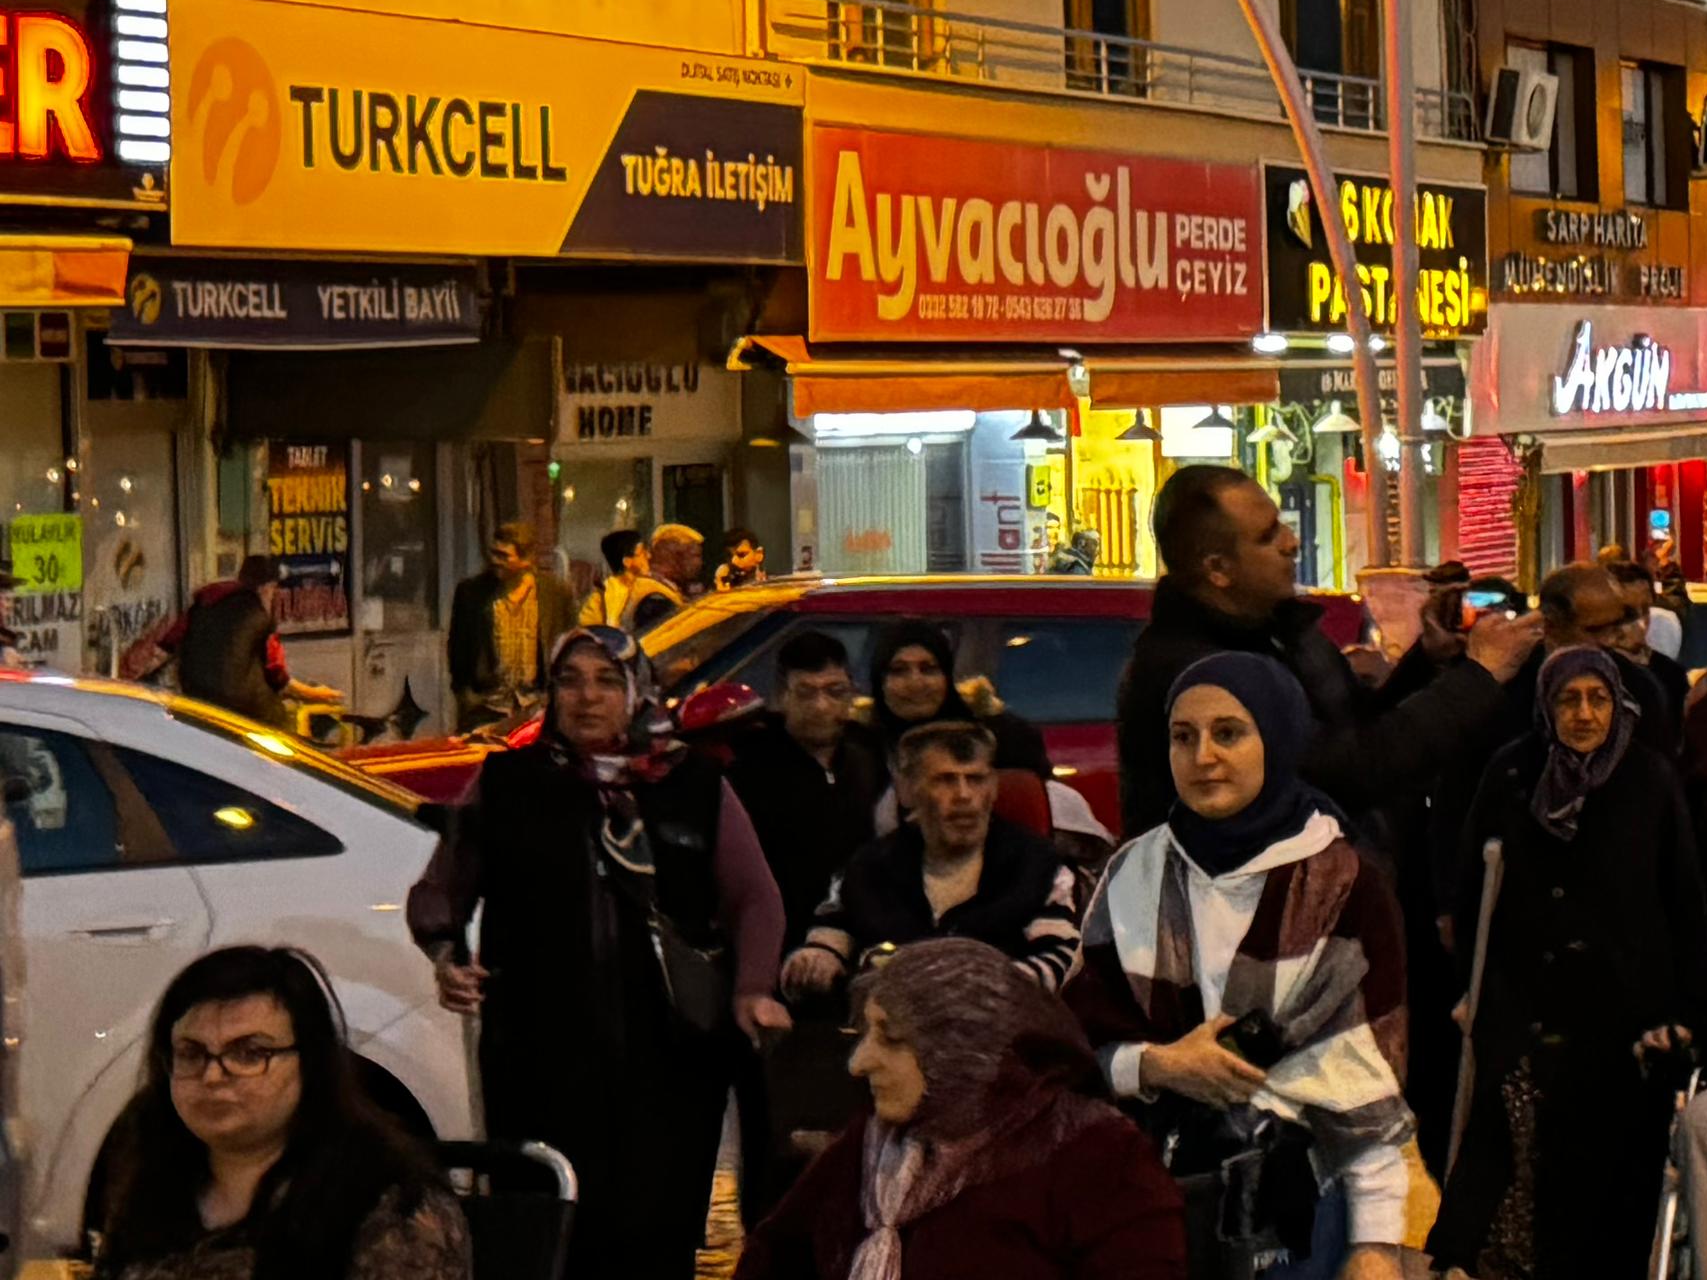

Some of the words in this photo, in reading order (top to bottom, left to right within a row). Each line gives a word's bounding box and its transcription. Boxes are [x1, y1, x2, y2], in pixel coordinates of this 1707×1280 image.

[0, 11, 101, 161] R
[289, 84, 567, 182] TURKCELL
[620, 145, 702, 199] TUĞRA
[705, 148, 794, 213] İLETİŞİM
[1176, 213, 1247, 252] PERDE
[1340, 180, 1360, 242] 6
[1547, 210, 1590, 244] SARP
[825, 150, 1170, 322] Ayvacıoğlu
[172, 280, 288, 319] TURKCELL
[317, 276, 400, 320] YETKİLİ
[1176, 259, 1248, 302] ÇEYİZ
[578, 404, 653, 439] HOME
[32, 553, 60, 585] 30
